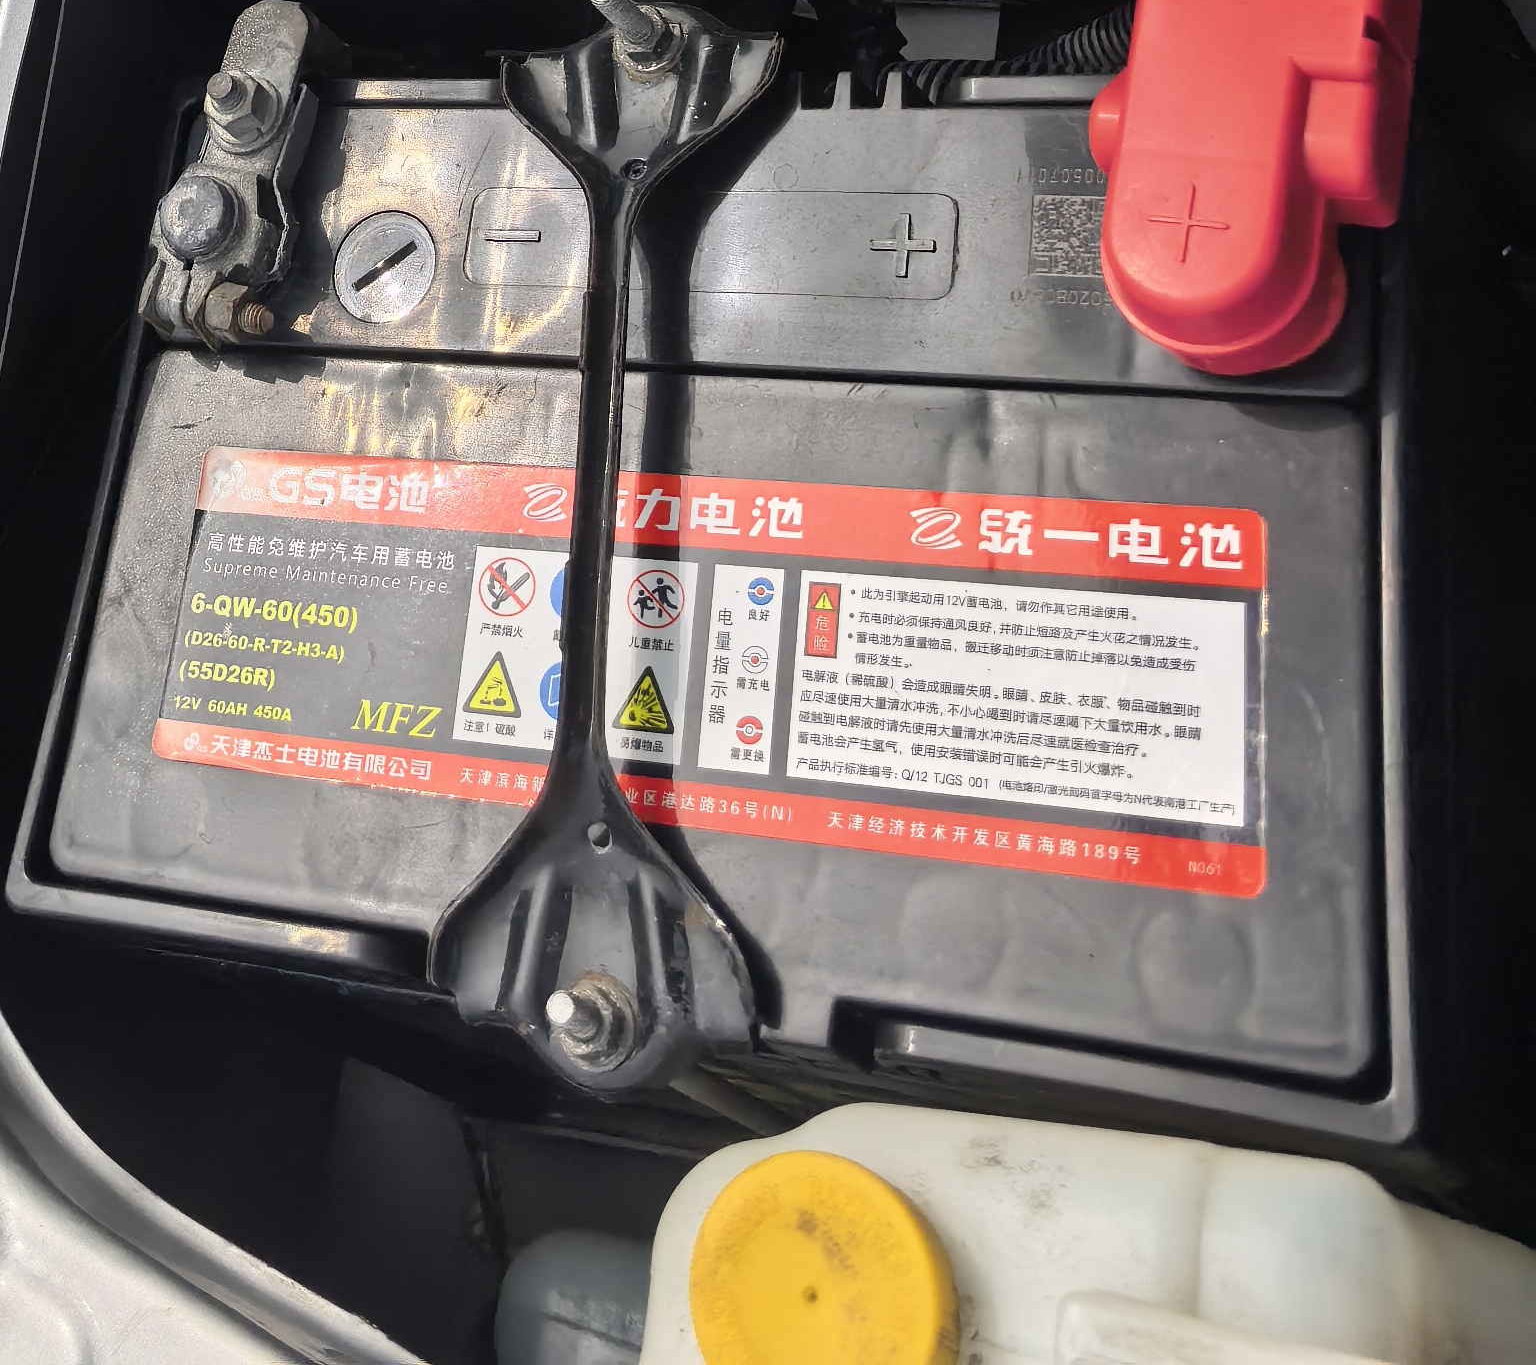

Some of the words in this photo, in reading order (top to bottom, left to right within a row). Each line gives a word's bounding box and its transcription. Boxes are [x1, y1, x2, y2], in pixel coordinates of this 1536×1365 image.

[268, 465, 431, 515] GS电池
[616, 487, 803, 539] 力电池
[207, 531, 456, 571] 高性能免维护汽车用蓄电池
[977, 507, 1243, 570] 统一电池
[204, 557, 278, 579] Supreme
[285, 563, 402, 590] Maintenance
[408, 575, 448, 594] Free
[190, 592, 358, 634] 6-QW-60(450)
[479, 622, 523, 638] 严禁烟火
[747, 608, 770, 622] 良好
[184, 629, 346, 664] (D26-60-R-T2-H3-A)
[628, 635, 675, 652] 儿童禁止
[814, 614, 830, 652] 危险
[179, 659, 276, 691] (55D26R)
[709, 607, 733, 725] 电量指示器
[173, 696, 202, 710] 12V
[208, 700, 247, 716] 60AH
[253, 704, 292, 722] 450A
[351, 698, 443, 739] MFZ
[209, 733, 432, 780] 天津杰士电池有限公司
[969, 777, 989, 790] 001
